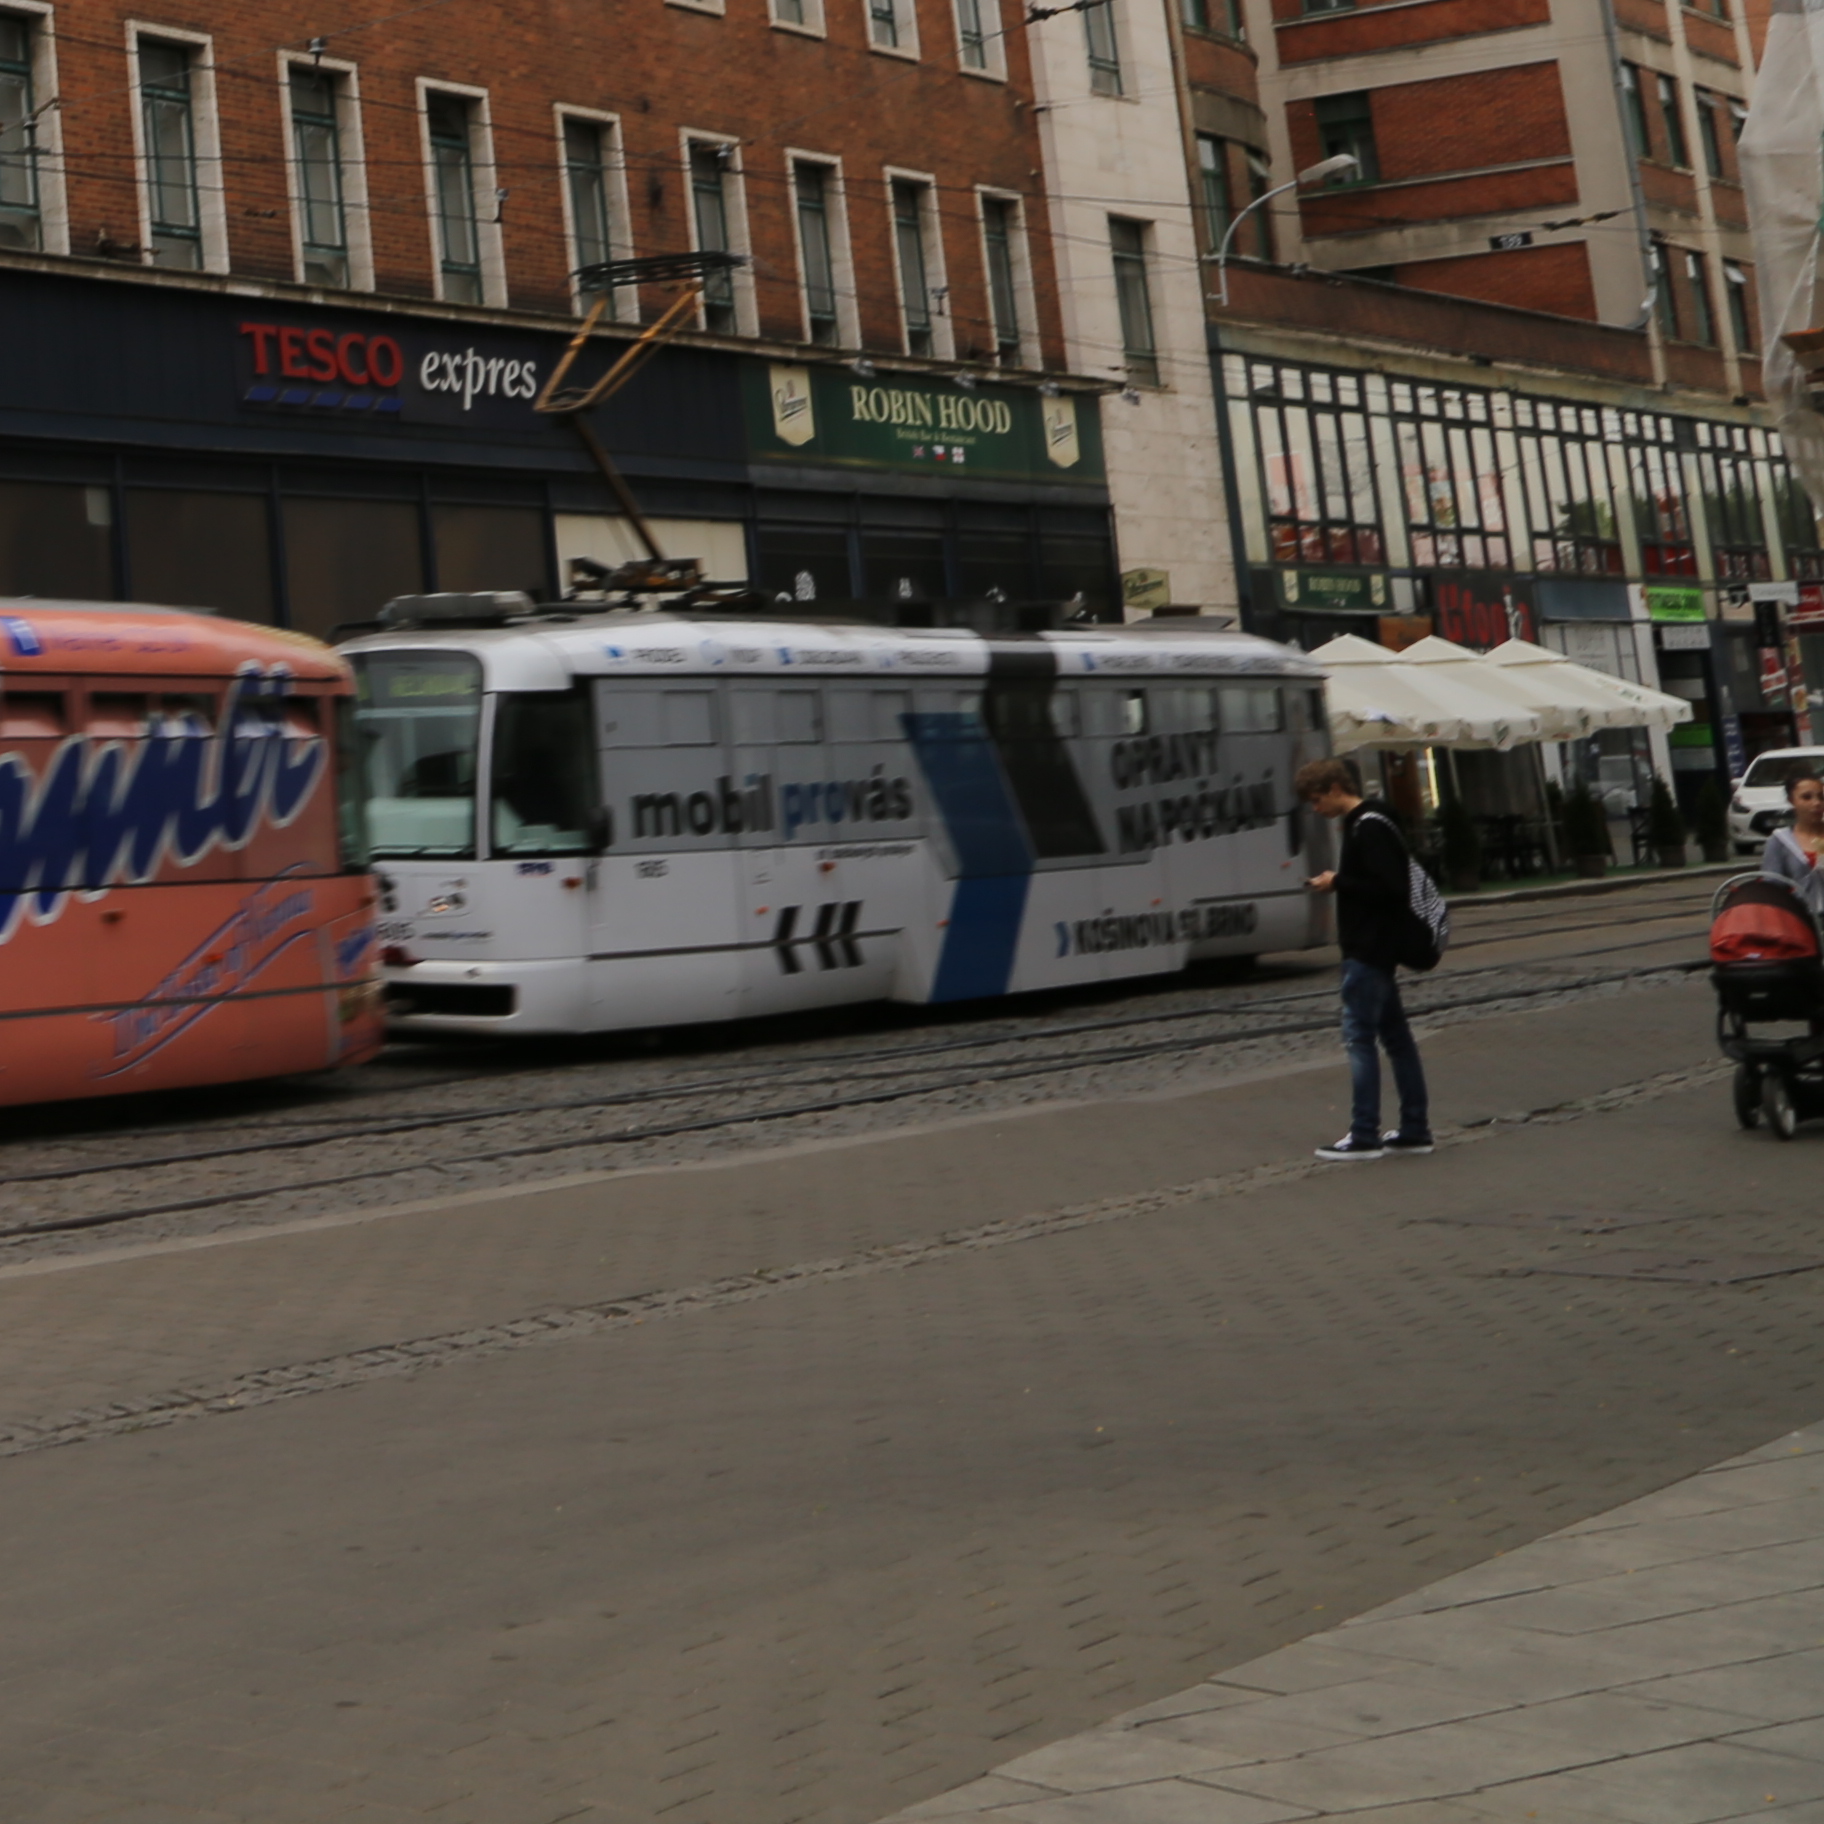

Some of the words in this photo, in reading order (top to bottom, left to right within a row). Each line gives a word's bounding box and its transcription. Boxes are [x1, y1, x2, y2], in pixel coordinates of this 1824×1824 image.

[241, 323, 403, 386] TESCO
[420, 347, 537, 410] expres
[851, 385, 932, 427] ROBIN
[937, 394, 1012, 434] HOOD
[632, 773, 774, 839] mobil
